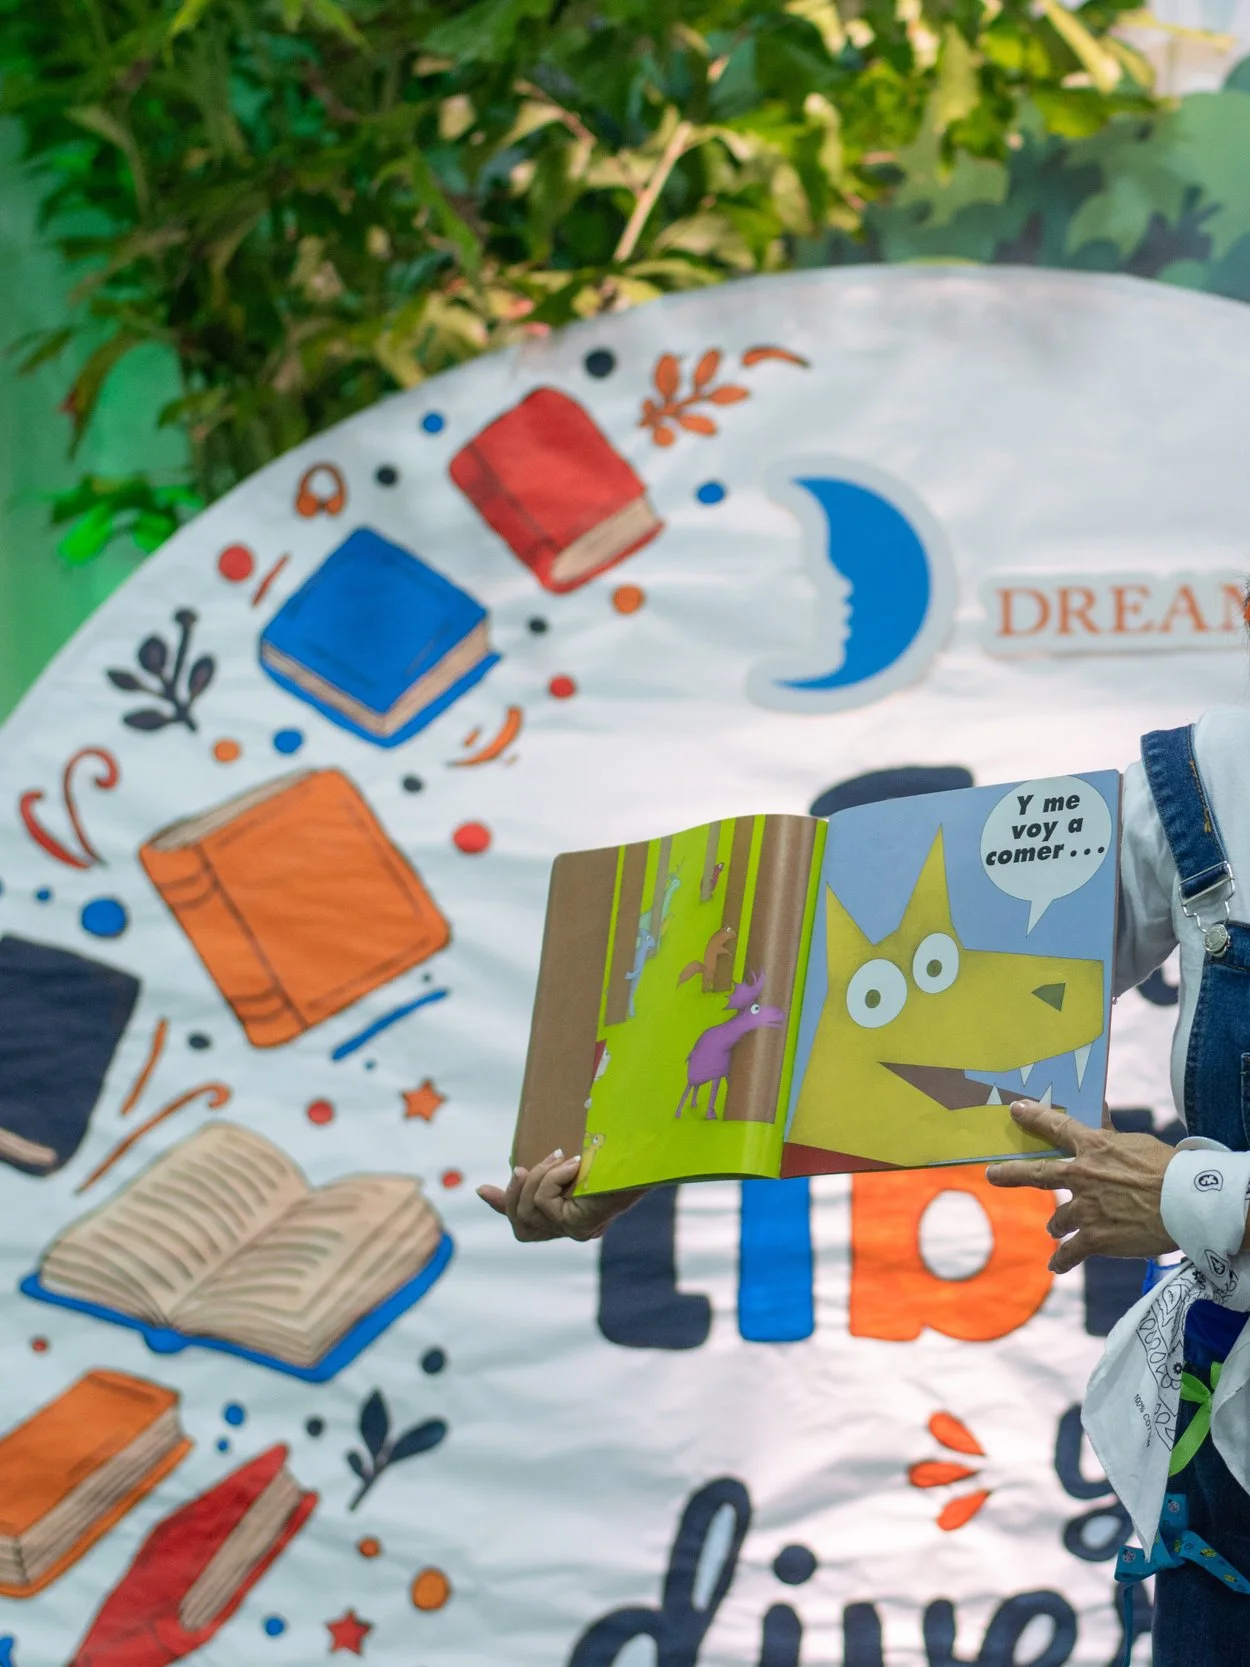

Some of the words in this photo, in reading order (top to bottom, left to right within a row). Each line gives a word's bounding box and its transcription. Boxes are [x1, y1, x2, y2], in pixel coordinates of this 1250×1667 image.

[1017, 794, 1034, 815] Y
[1043, 794, 1080, 813] me
[1012, 820, 1059, 842] voy
[1067, 817, 1083, 833] a
[1134, 1393, 1146, 1413] 100%
